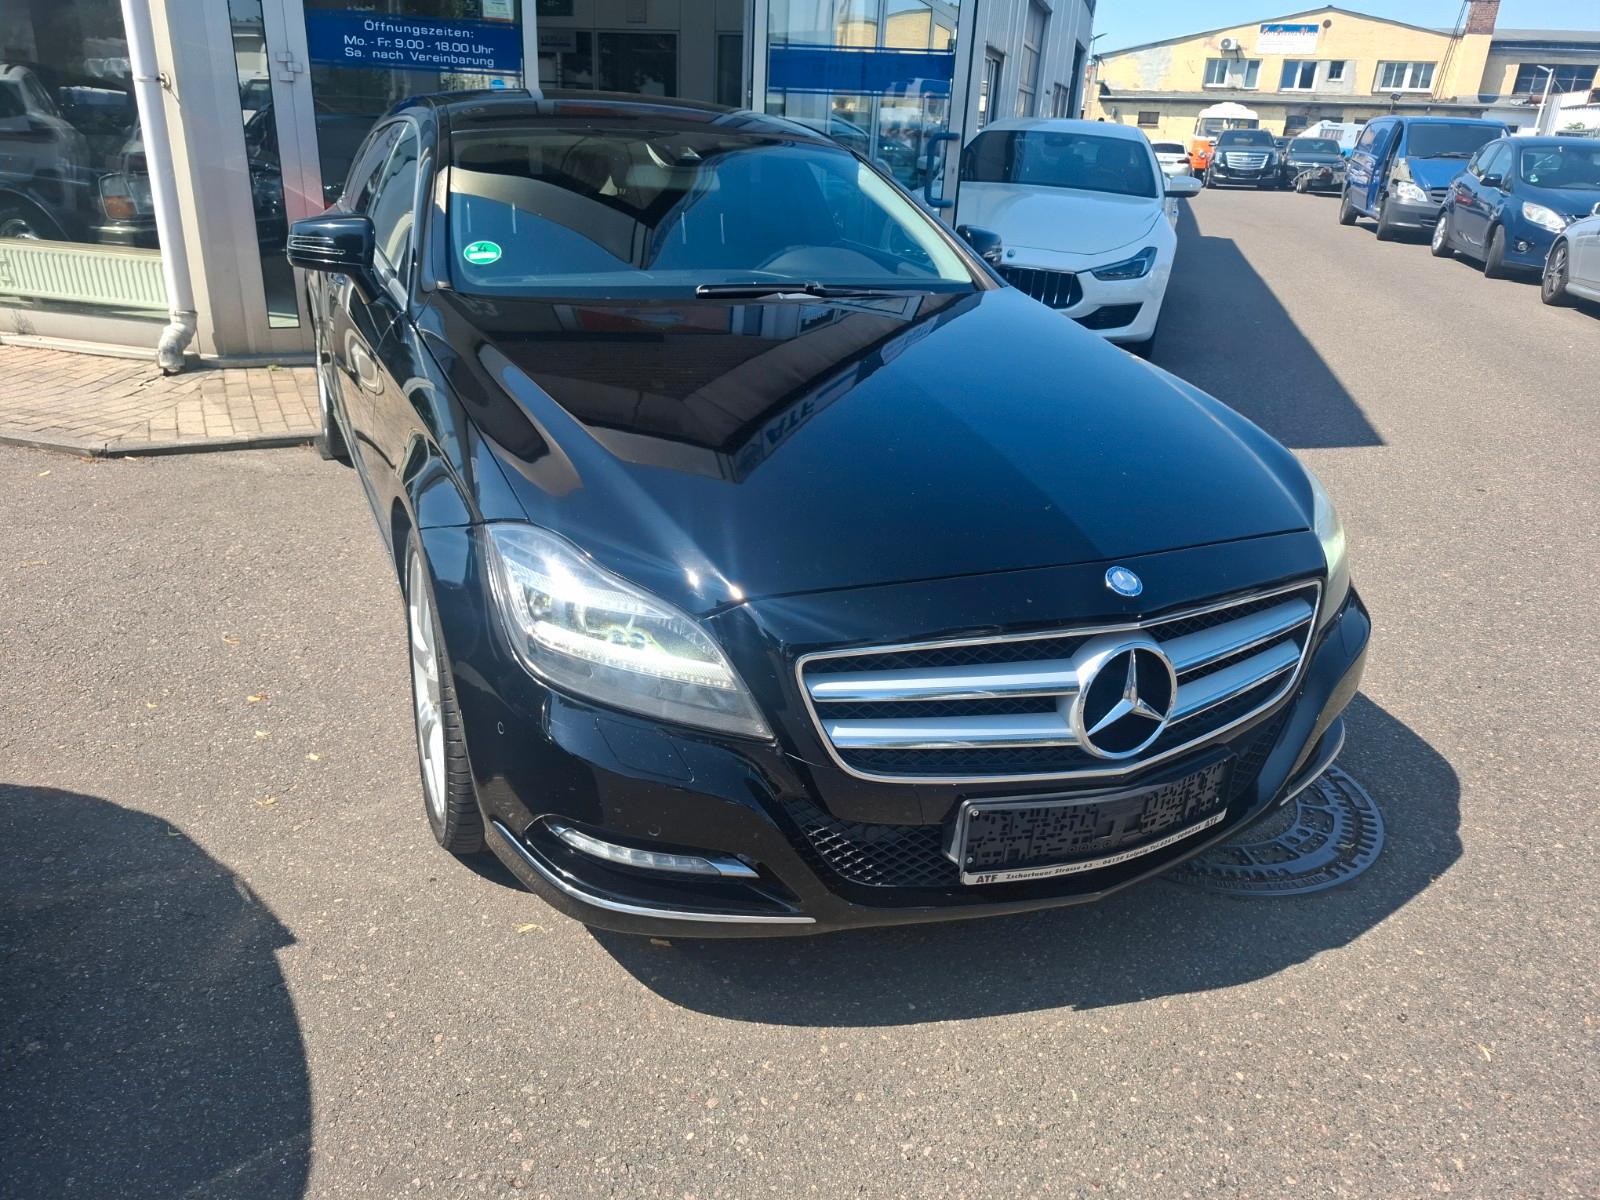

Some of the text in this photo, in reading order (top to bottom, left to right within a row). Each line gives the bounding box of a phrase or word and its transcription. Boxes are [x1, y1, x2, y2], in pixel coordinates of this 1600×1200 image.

[364, 20, 474, 38] Öffnungszeiten:
[344, 34, 367, 46] Mo.
[377, 37, 392, 47] Fr.
[395, 38, 424, 50] 9.00
[434, 41, 470, 53] 18.00
[472, 44, 495, 54] Uhr
[344, 46, 494, 68] Sa. nach Vereinbarung
[976, 874, 999, 884] ATF
